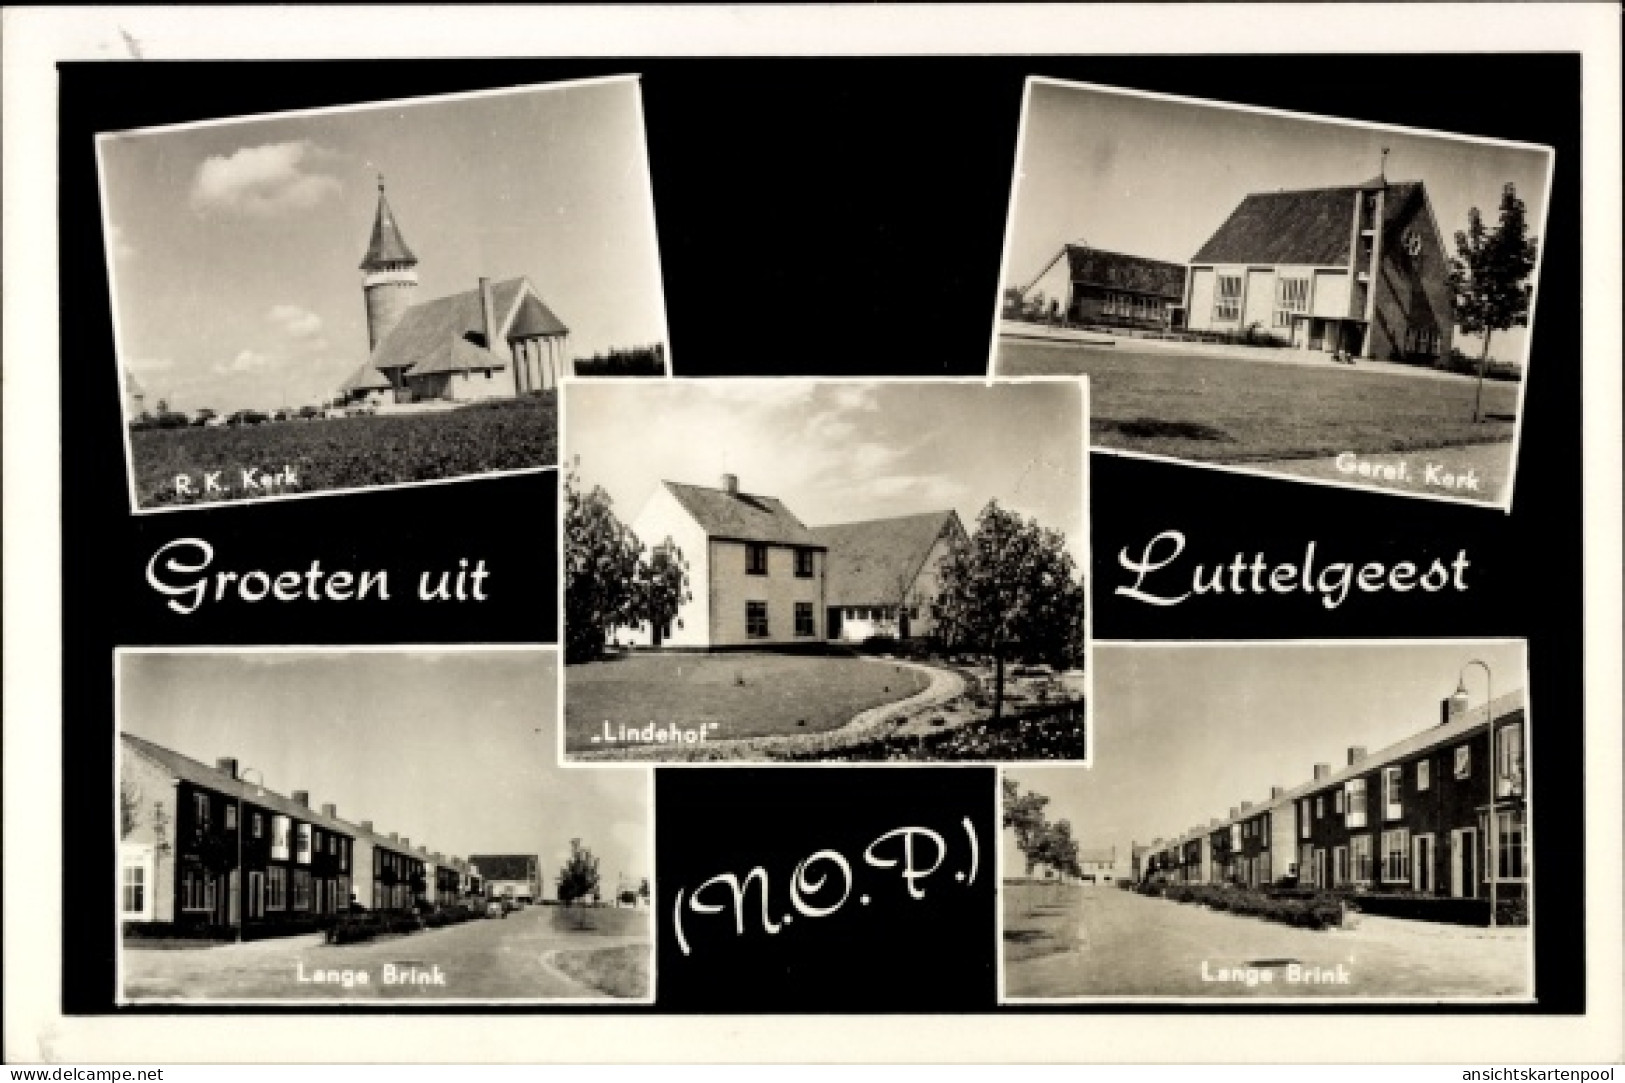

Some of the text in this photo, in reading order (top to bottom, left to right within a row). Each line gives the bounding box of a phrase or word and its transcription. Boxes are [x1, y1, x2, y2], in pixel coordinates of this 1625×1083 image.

[242, 464, 299, 489] Kerk
[1425, 462, 1480, 491] Kerk
[146, 537, 490, 615] Groeten uit
[1114, 529, 1470, 609] Luttelgeest
[673, 816, 979, 956] (N.O.P.)
[296, 960, 446, 989] Lange Brink
[1201, 960, 1351, 987] Lange Brink
